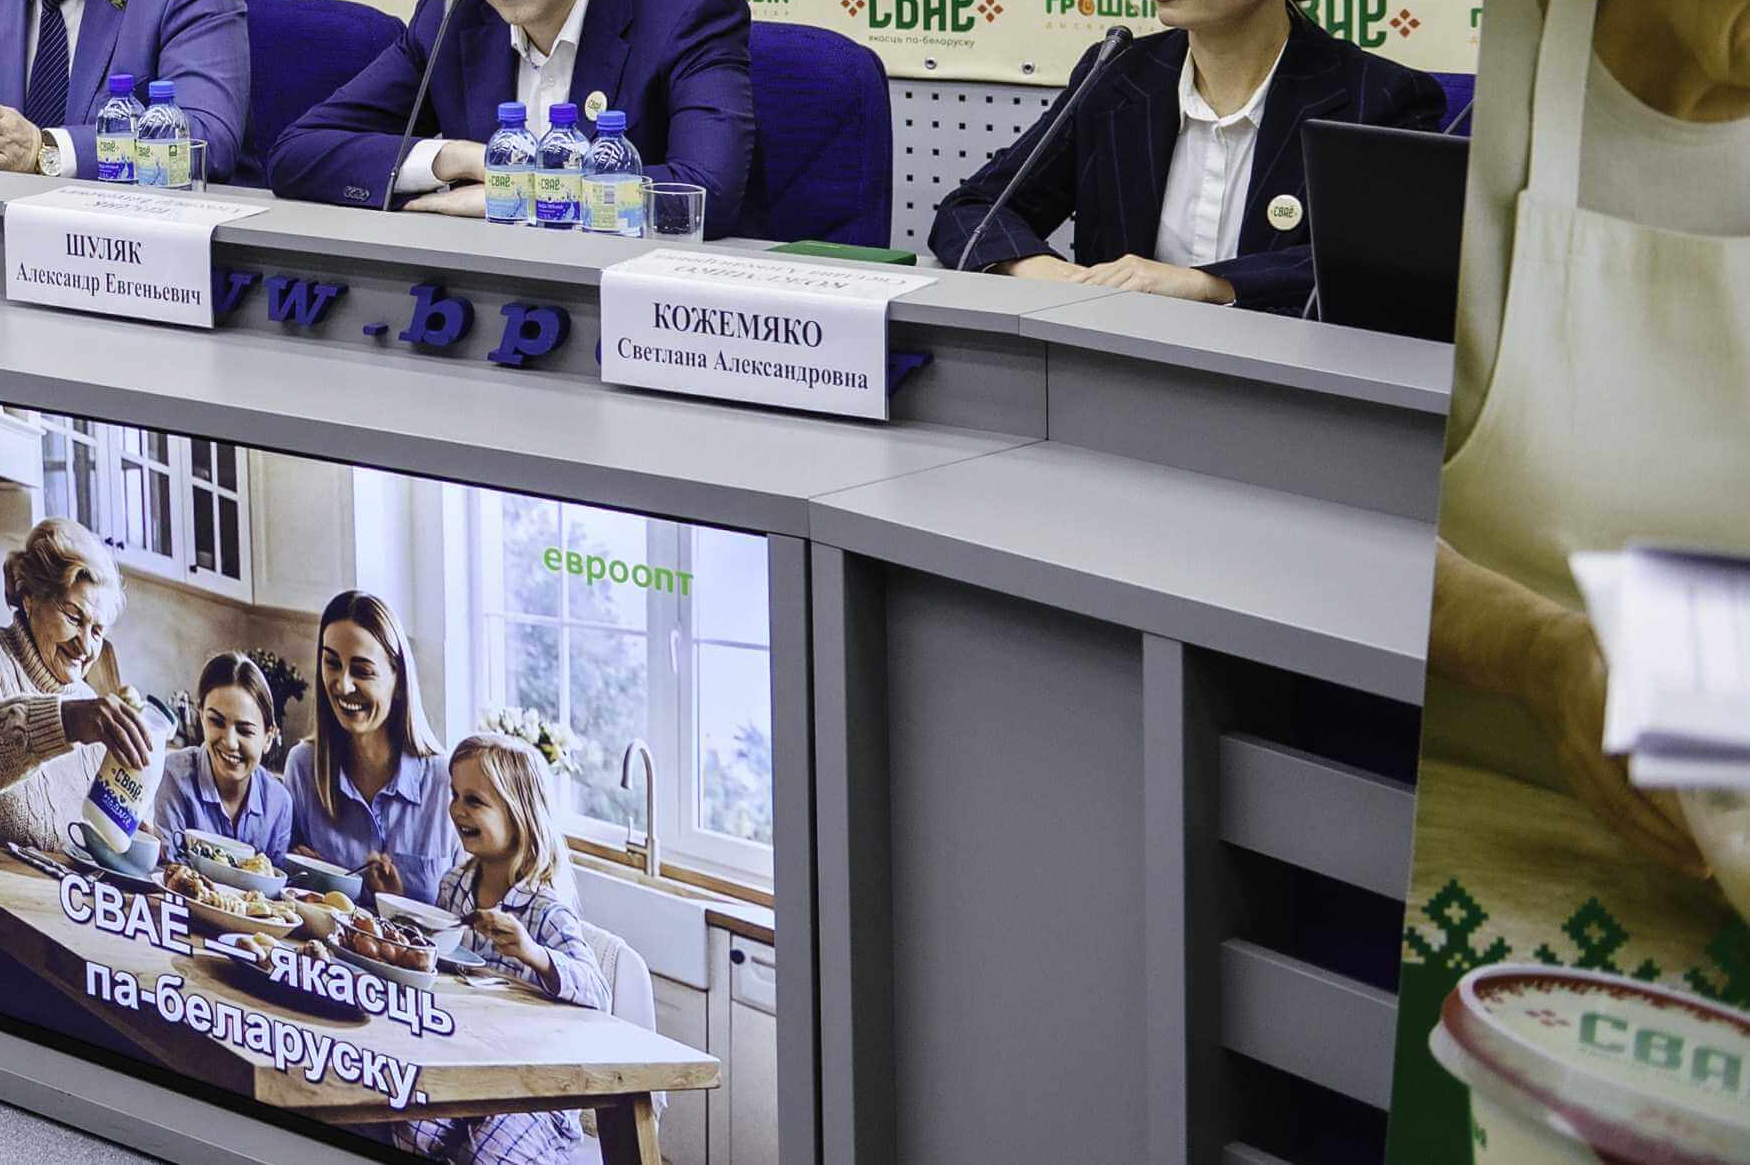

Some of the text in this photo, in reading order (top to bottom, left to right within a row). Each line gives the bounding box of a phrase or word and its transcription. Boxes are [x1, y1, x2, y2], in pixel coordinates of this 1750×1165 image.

[65, 233, 143, 266] ШУЛЯК
[16, 262, 203, 307] Александр Евгеньевич
[652, 301, 823, 349] КОЖЕМЯКО
[617, 336, 869, 391] Светлана Александровна
[542, 544, 694, 598] евроопт
[59, 872, 454, 1037] СВАЁ якасць
[85, 960, 431, 1108] па-беларуску.
[1579, 1011, 1743, 1093] СВА
